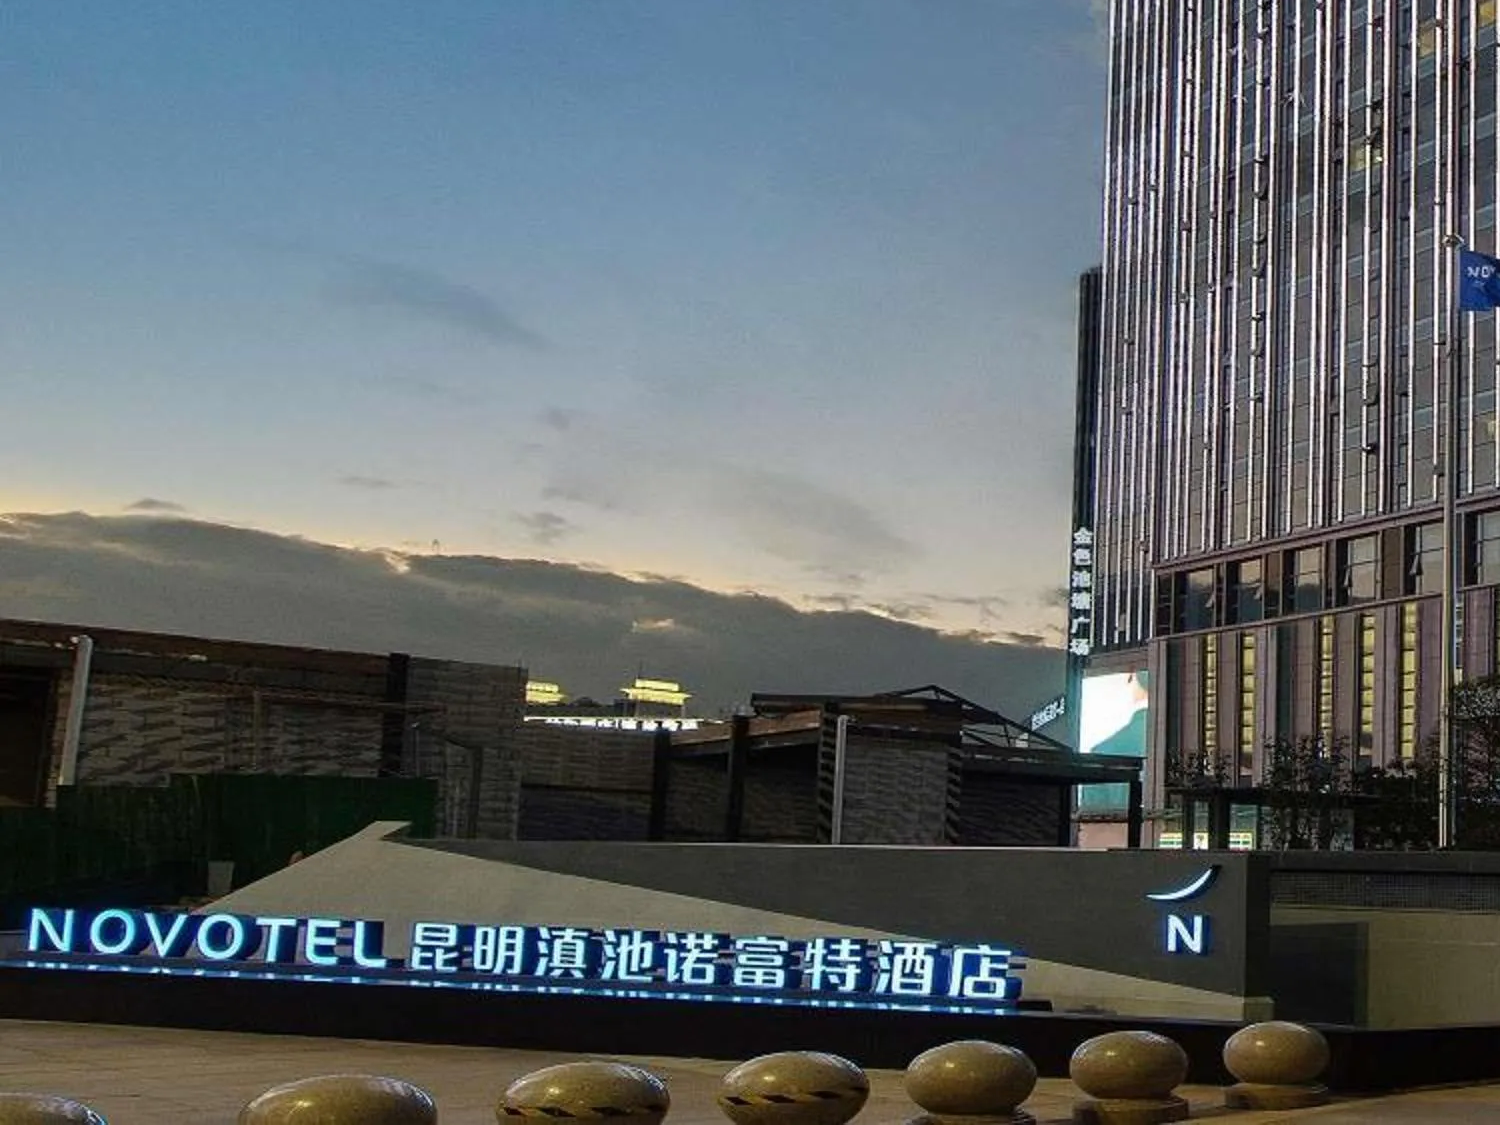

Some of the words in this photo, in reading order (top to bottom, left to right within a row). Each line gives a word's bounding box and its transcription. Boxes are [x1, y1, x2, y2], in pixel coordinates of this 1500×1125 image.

[27, 907, 387, 969] NOVOTEL
[409, 921, 1013, 1000] 昆明滇池诺富特酒店
[1167, 913, 1203, 954] N
